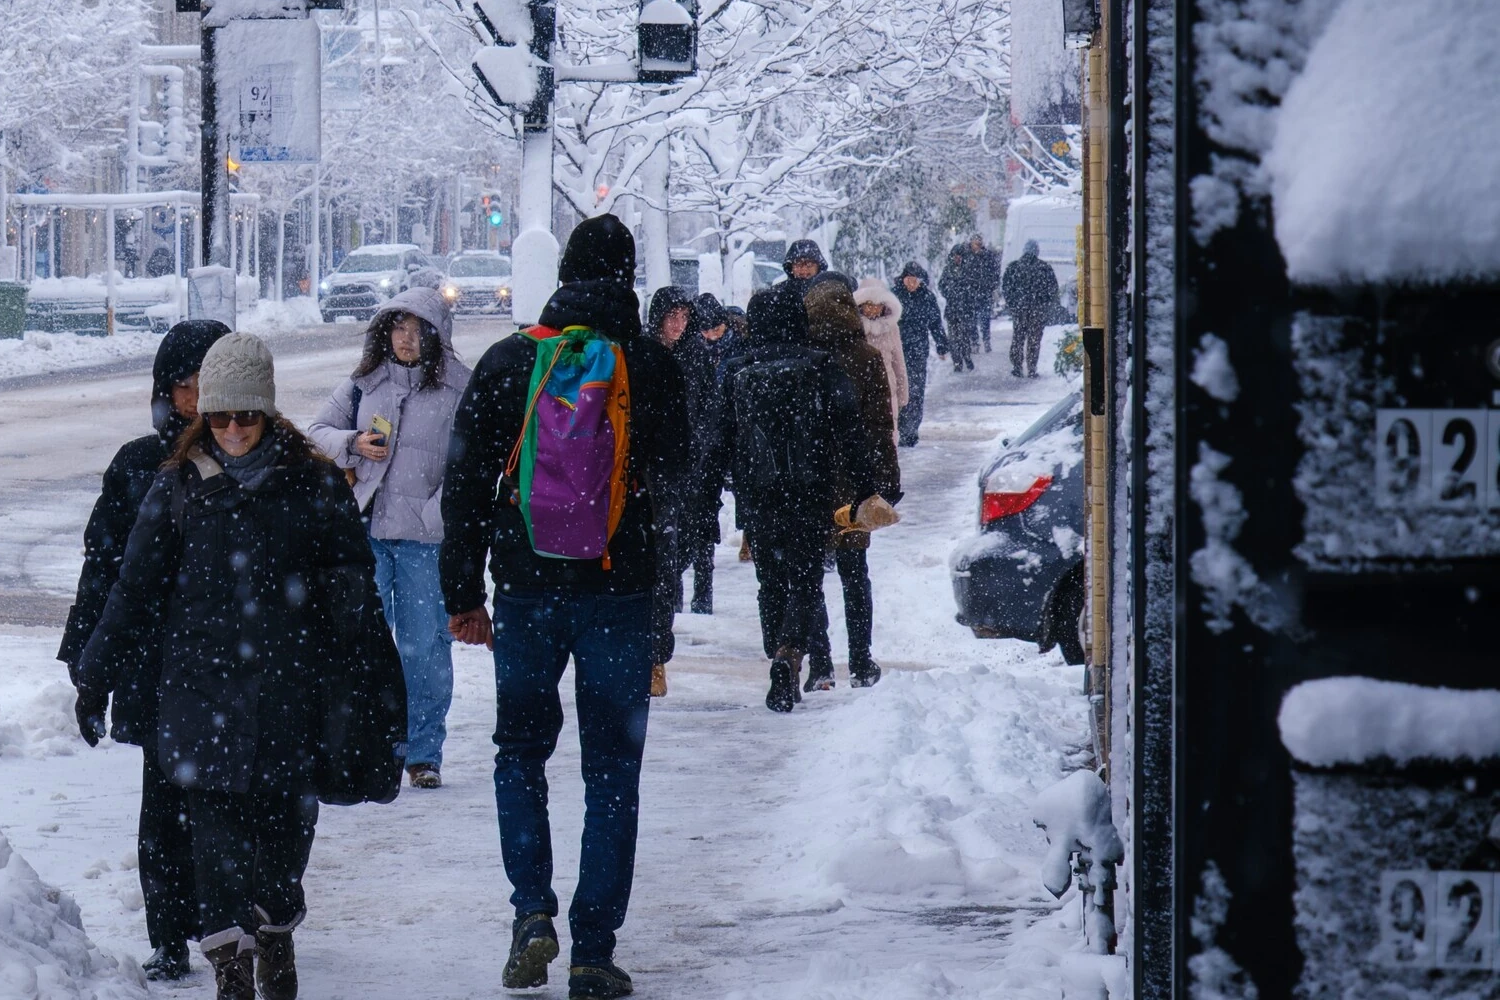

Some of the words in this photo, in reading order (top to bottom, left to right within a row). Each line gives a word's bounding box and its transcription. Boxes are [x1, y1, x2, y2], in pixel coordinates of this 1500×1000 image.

[251, 86, 270, 101] 97
[1387, 417, 1500, 502] 92
[1390, 879, 1500, 963] 92
